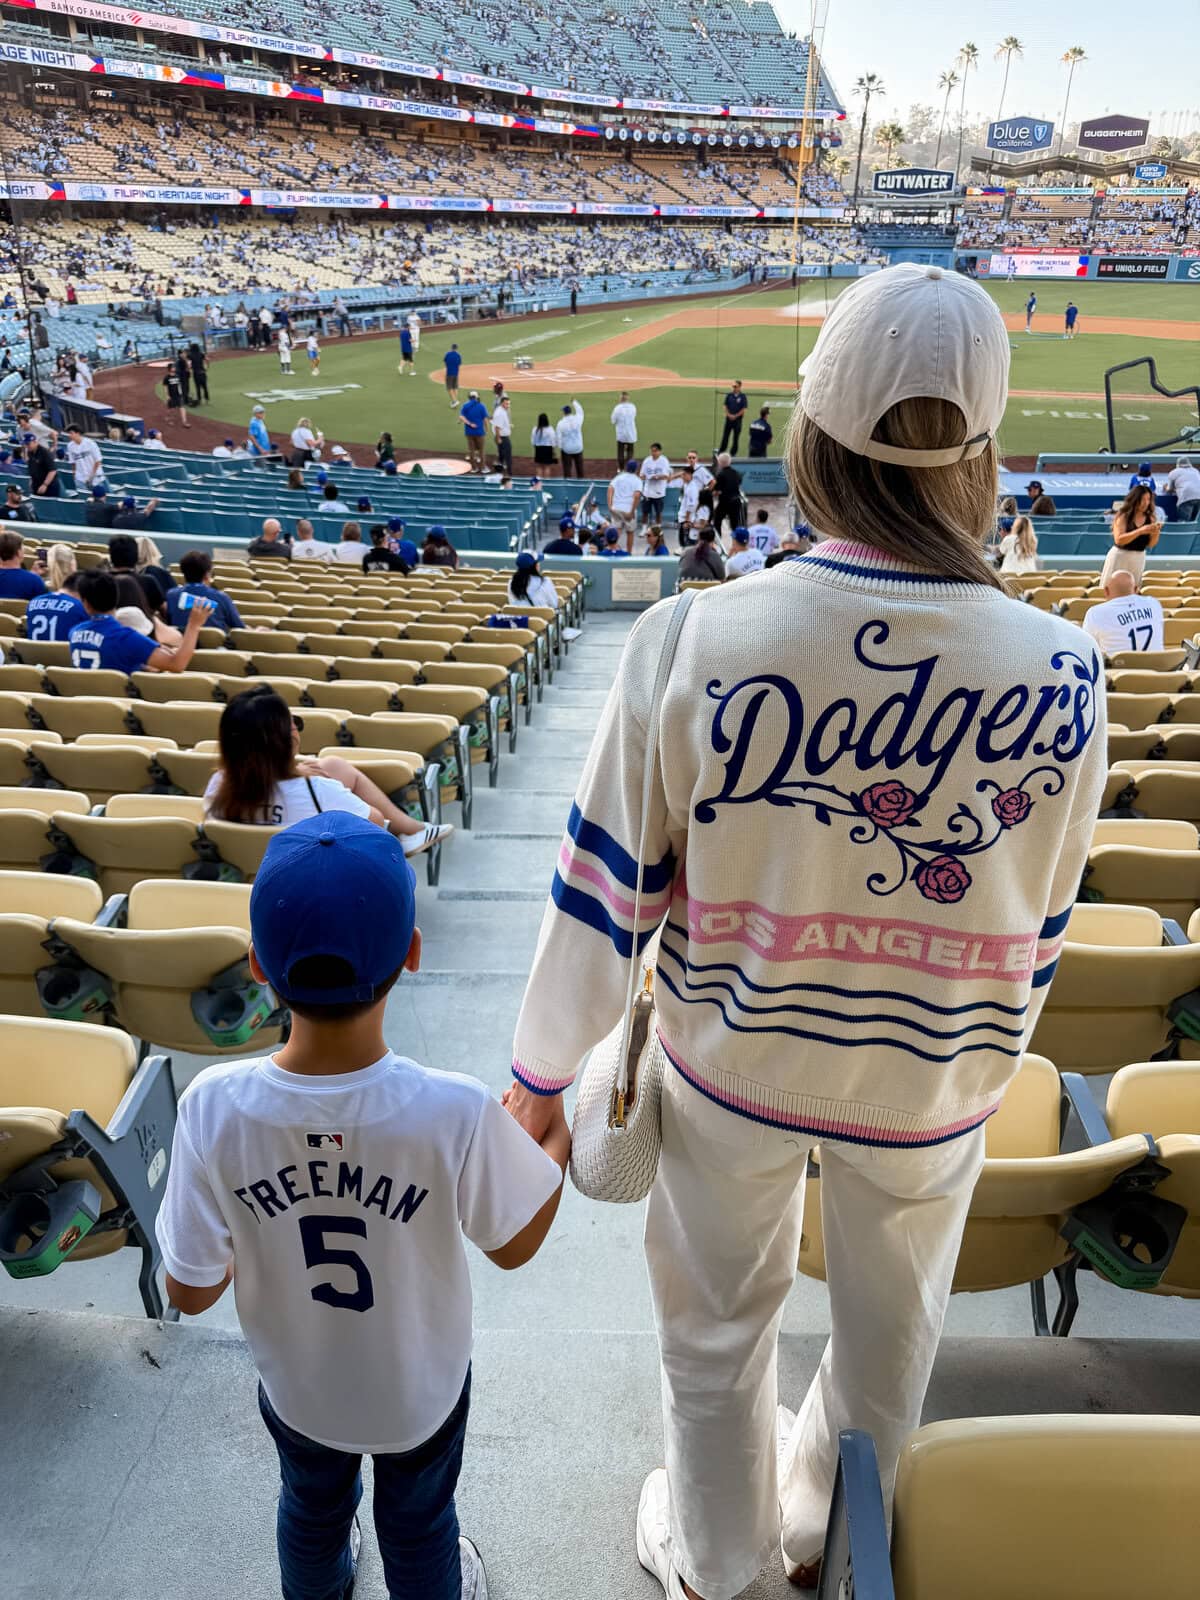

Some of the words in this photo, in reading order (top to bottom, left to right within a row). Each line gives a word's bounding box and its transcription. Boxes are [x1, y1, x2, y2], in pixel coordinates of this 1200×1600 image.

[51, 2, 75, 14] BANK
[77, 8, 87, 16] OF
[90, 9, 126, 23] AMERICA
[226, 32, 258, 44] FILIPINO
[260, 37, 295, 50] HERITAGE
[296, 44, 316, 54] NIGHT
[31, 49, 75, 67] NIGHT
[368, 98, 402, 111] FILIPINO
[403, 103, 440, 116] HERITAGE
[440, 109, 462, 119] NIGHT
[993, 123, 1030, 140] blue
[1084, 129, 1144, 137] GUGGENHEIM
[997, 139, 1033, 147] california
[0, 185, 36, 196] NIGHT
[878, 174, 948, 189] CUTWATER
[114, 188, 155, 199] FILIPINO
[159, 190, 202, 200] HERITAGE
[204, 191, 231, 201] NIGHT
[287, 194, 317, 203] FILIPINO
[1115, 264, 1142, 273] UNIQLO
[1143, 265, 1166, 273] FIELD
[1021, 409, 1150, 421] FIELD
[756, 536, 768, 551] 17
[29, 598, 75, 612] BUEHLER
[1117, 607, 1153, 626] OHTANI
[32, 615, 58, 641] 21
[1128, 625, 1153, 651] 17
[72, 648, 101, 670] 17
[695, 620, 1098, 823] Dodgers
[689, 911, 777, 948] OS
[792, 912, 1034, 972] ANGELE
[233, 1160, 429, 1225] FREEMAN
[298, 1215, 374, 1312] 5
